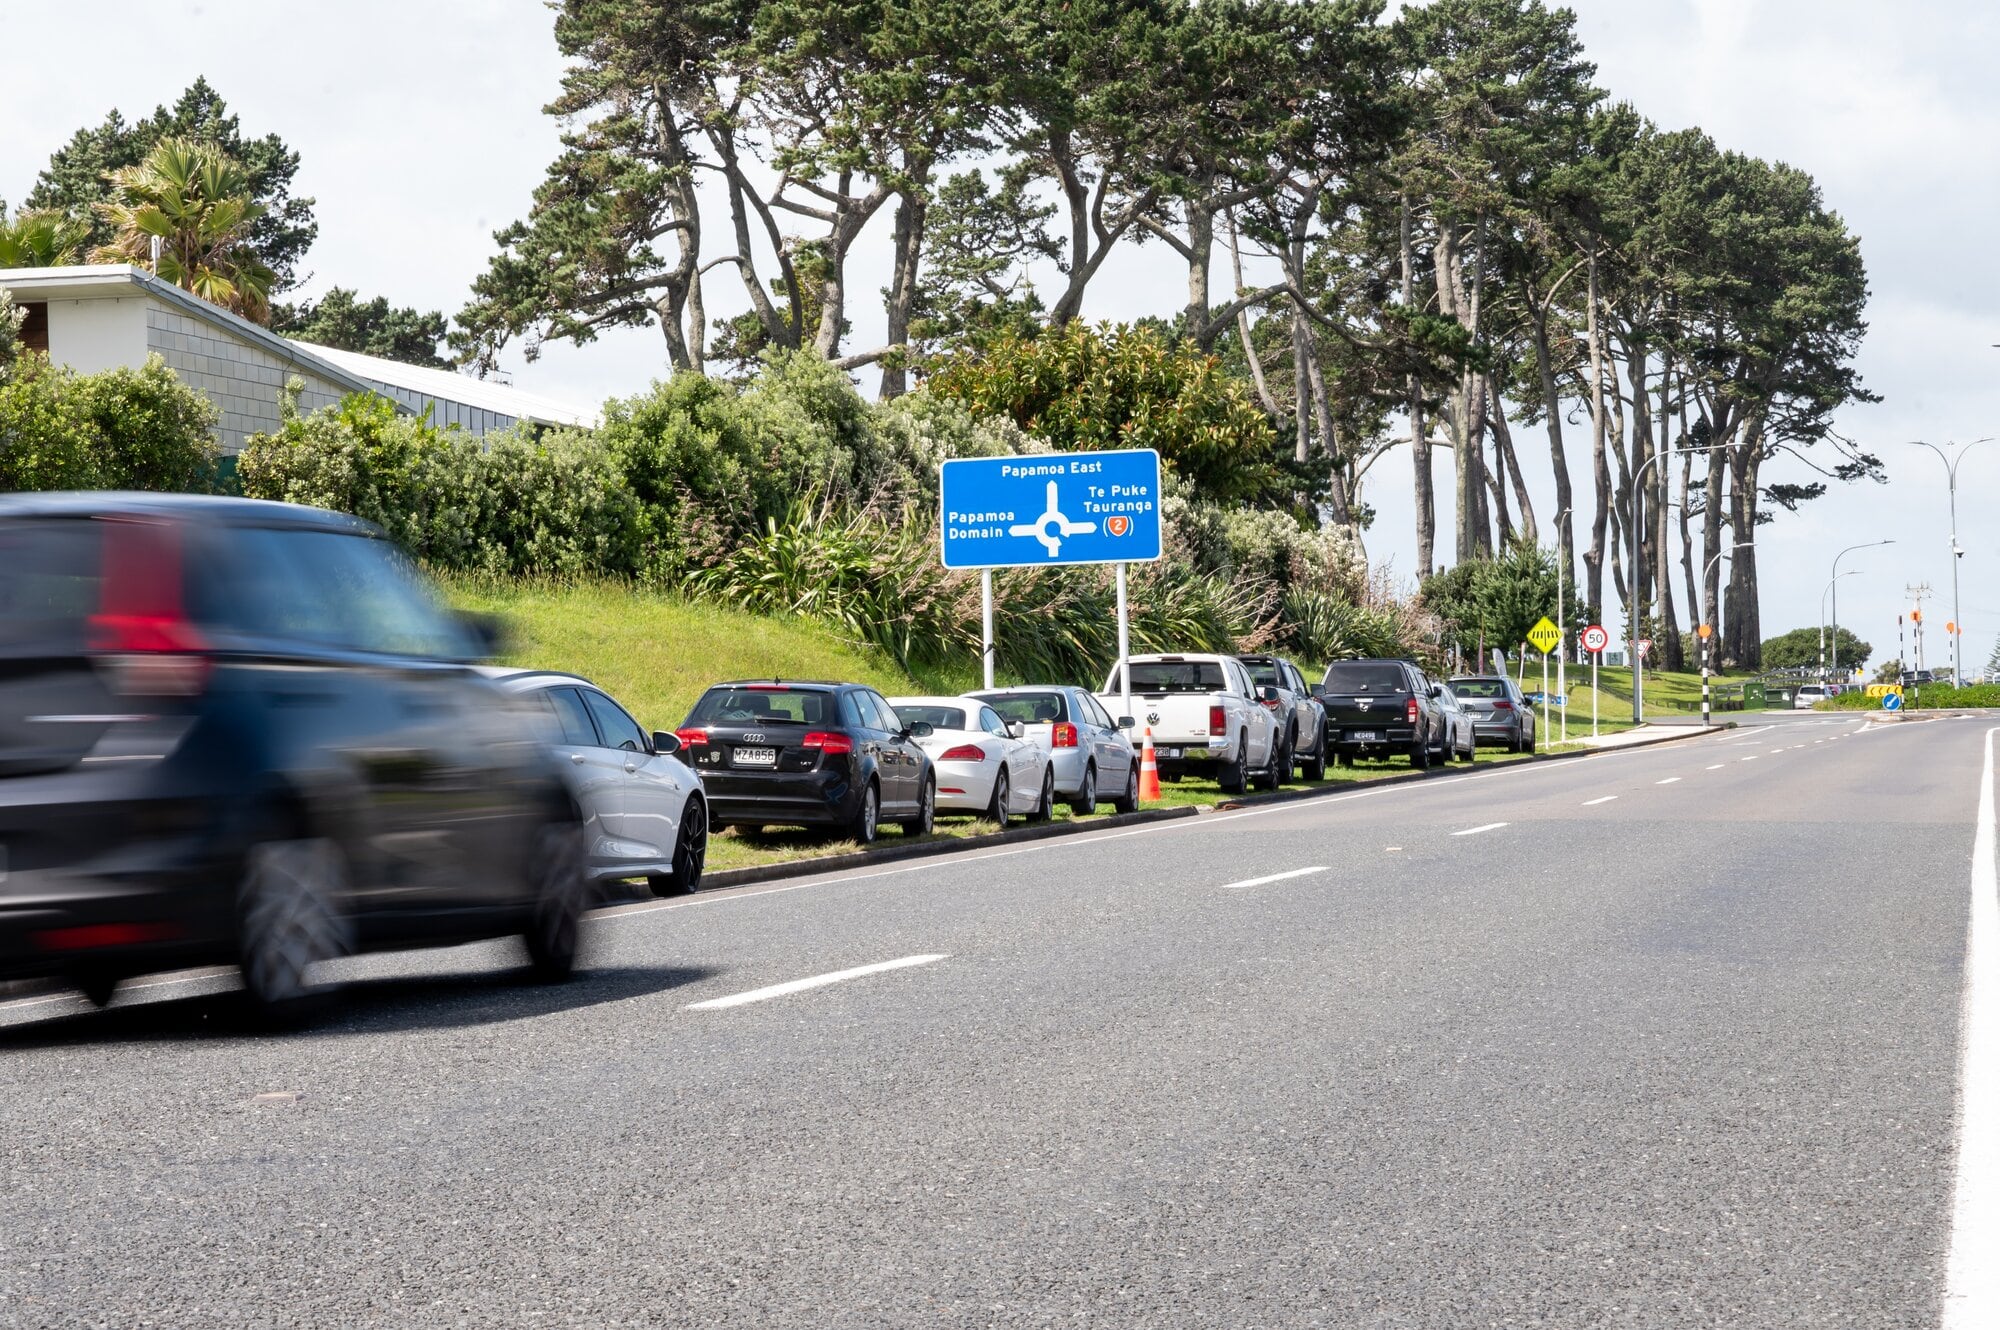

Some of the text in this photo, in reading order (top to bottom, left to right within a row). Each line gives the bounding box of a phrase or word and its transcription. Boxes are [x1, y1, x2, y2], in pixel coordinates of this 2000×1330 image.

[1001, 461, 1102, 478] Papamoa East
[1088, 485, 1147, 498] Te Puke
[1083, 501, 1152, 514] Tauranga
[949, 511, 1015, 525] Papamoa
[949, 527, 1003, 540] Domain
[1588, 633, 1603, 643] 50
[734, 750, 774, 761] MZA856
